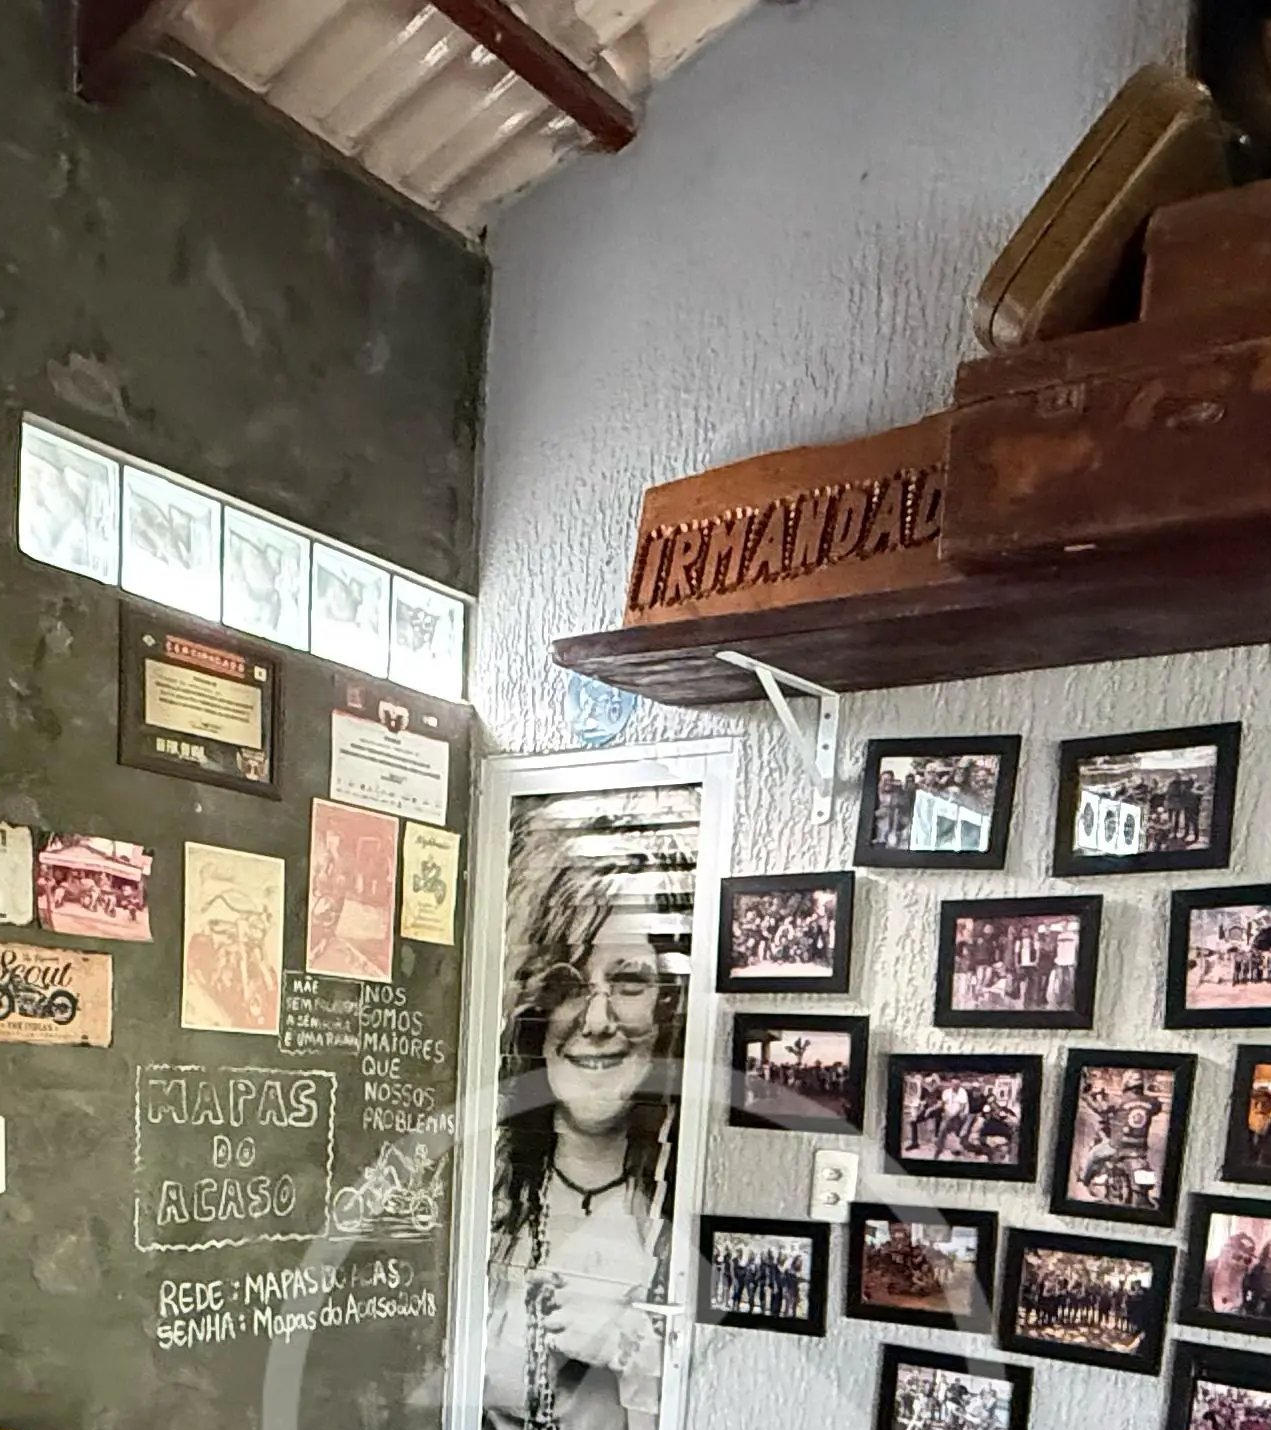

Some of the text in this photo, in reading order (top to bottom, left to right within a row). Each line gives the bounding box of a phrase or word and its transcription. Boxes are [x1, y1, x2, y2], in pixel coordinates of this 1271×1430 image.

[365, 984, 407, 1007] NOS
[361, 1004, 423, 1037] SOMOS
[361, 1055, 401, 1080] QUE
[146, 1078, 319, 1129] MAPAS
[364, 1081, 436, 1112] NOSSOS
[362, 1106, 456, 1135] PROBLEMAS
[212, 1135, 256, 1169] DO
[156, 1173, 297, 1227] ACASO
[244, 1266, 319, 1305] MAPAS
